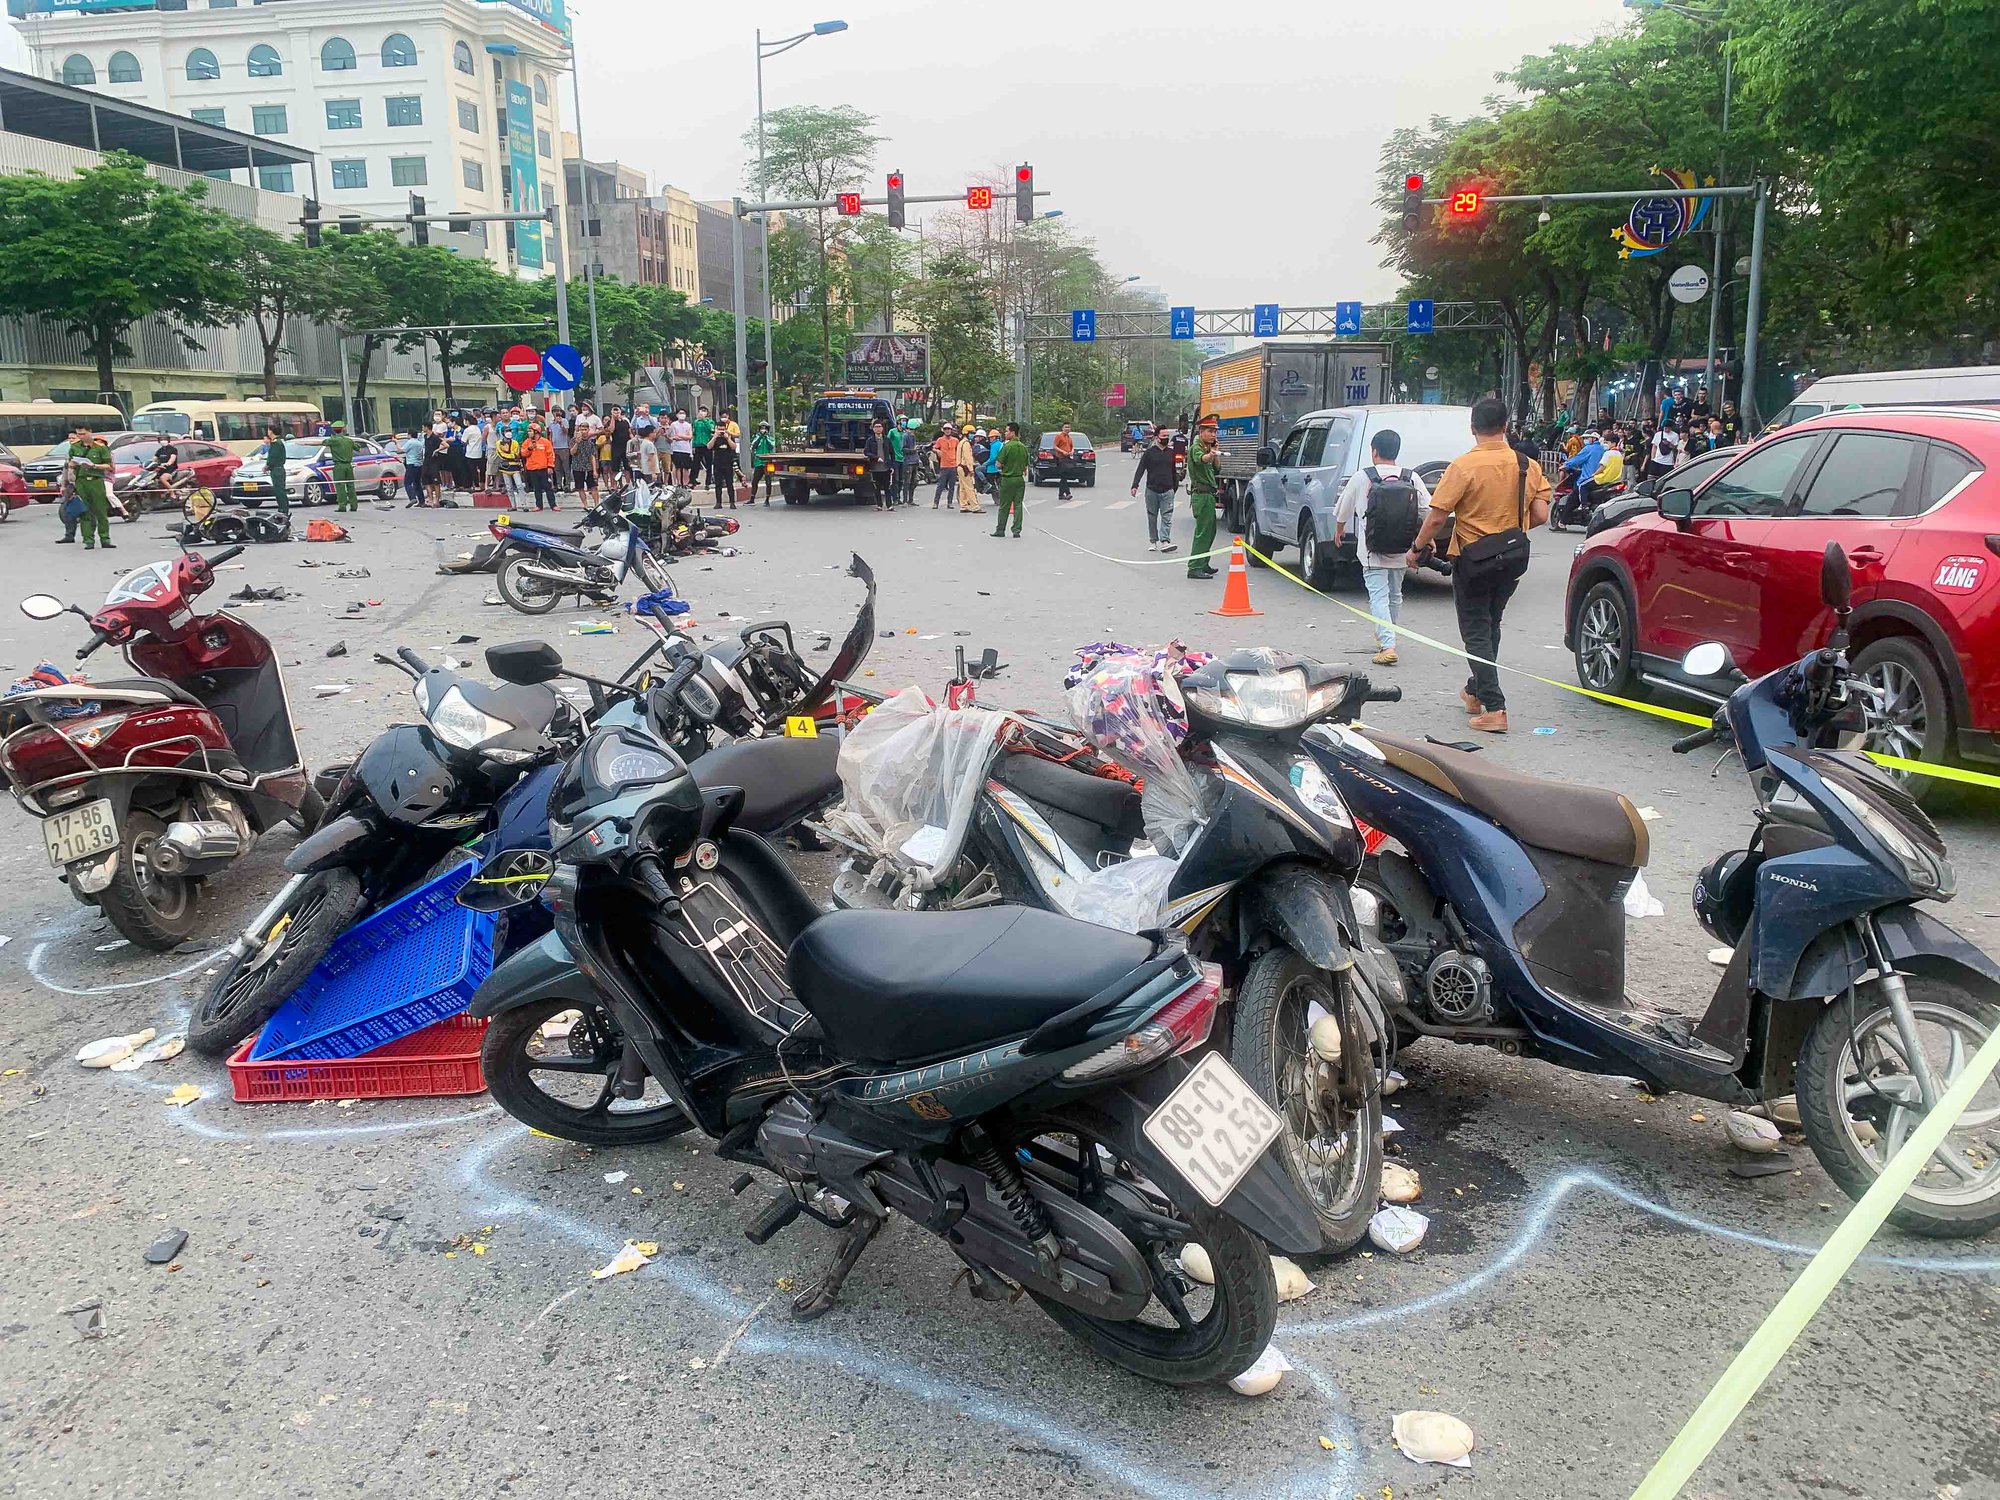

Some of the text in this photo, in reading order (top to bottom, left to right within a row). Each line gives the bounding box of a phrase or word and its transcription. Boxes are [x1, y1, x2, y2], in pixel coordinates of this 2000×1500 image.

[970, 189, 989, 207] 29
[1455, 193, 1477, 212] 29
[1351, 366, 1367, 381] XE
[1346, 383, 1370, 400] THƯ
[1935, 563, 1978, 588] XĂNG
[135, 716, 175, 726] LEAD
[797, 719, 808, 733] 4
[1340, 760, 1399, 794] VISION
[53, 806, 102, 839] 17-B6
[51, 824, 114, 864] 210.39
[1770, 872, 1820, 893] HONDA
[864, 1052, 990, 1095] GRAVITA
[1160, 1068, 1235, 1150] 89-C1
[1188, 1096, 1273, 1192] 142.53
